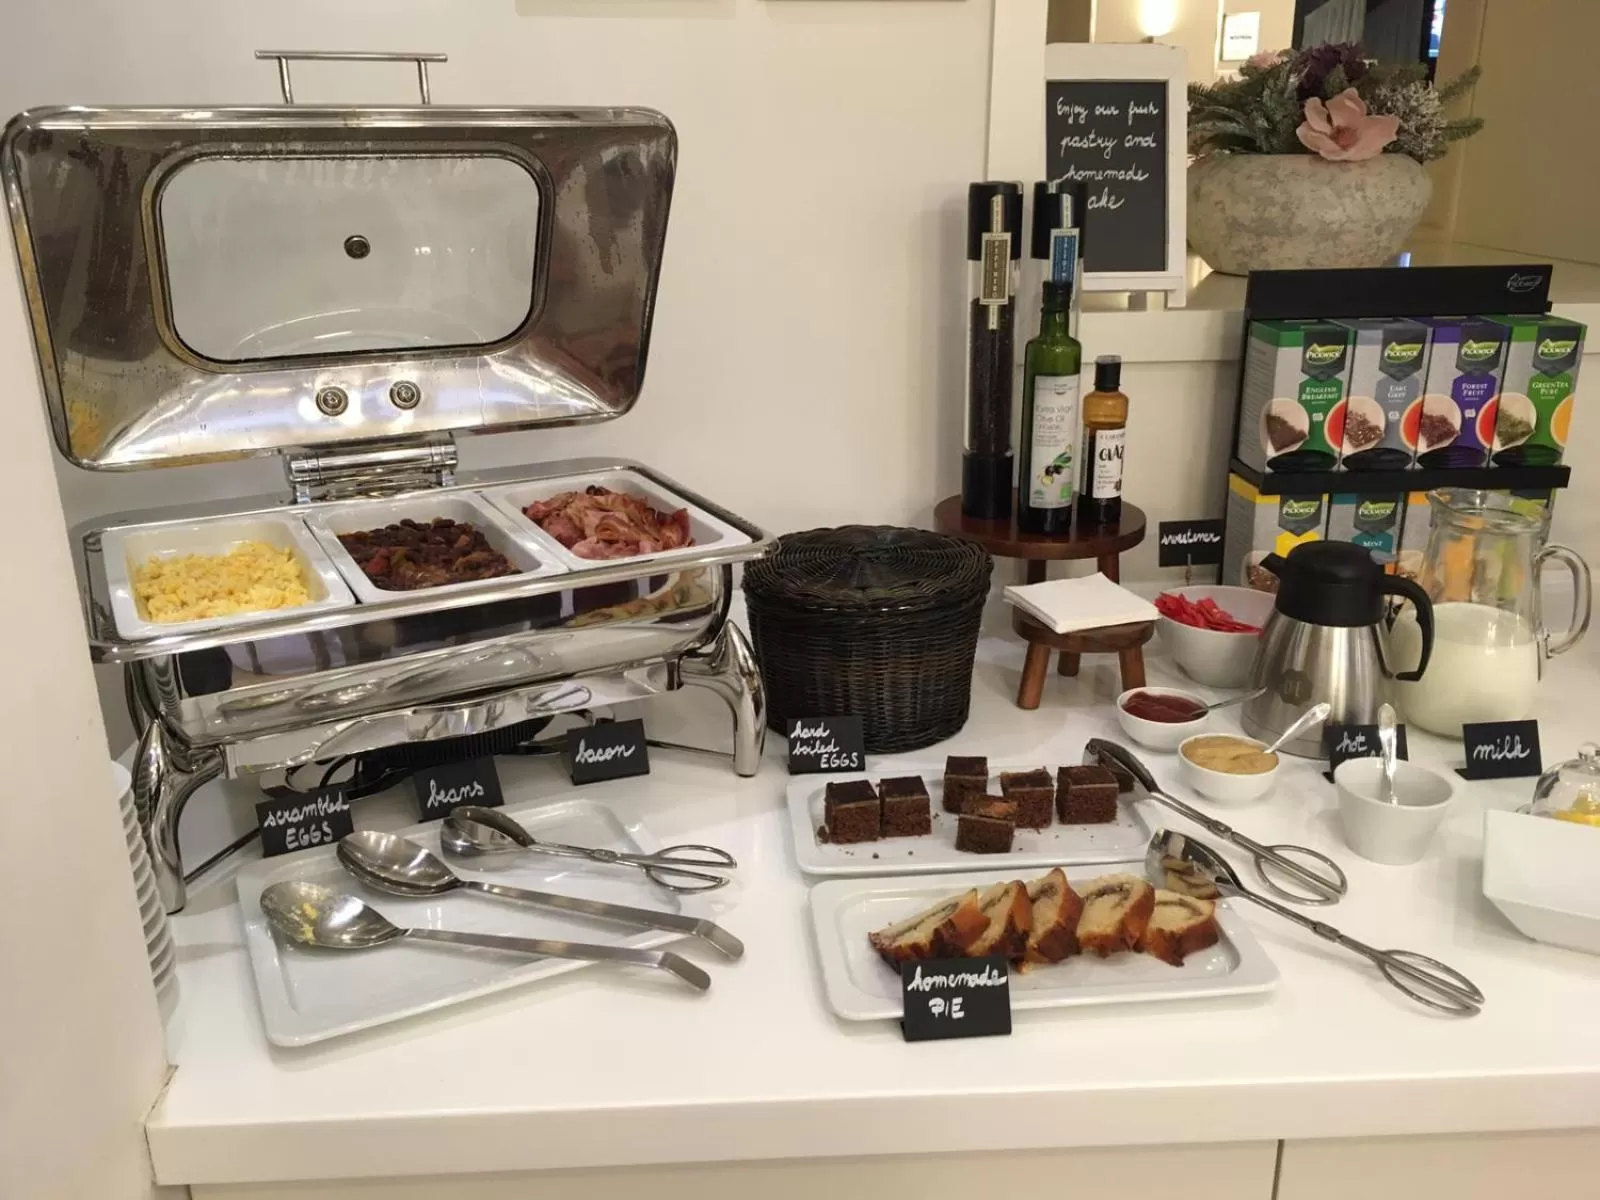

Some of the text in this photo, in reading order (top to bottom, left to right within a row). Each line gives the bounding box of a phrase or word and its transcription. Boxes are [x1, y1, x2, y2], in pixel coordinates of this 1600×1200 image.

[1057, 97, 1159, 126] Enjoy our fresh
[1061, 128, 1156, 159] pastry and
[1052, 162, 1149, 183] homemade
[1087, 186, 1125, 209] ake
[790, 720, 830, 739] hard
[1336, 731, 1368, 752] hot
[575, 738, 636, 764] bacon
[792, 738, 840, 756] boiled
[1473, 735, 1531, 760] milk
[820, 752, 859, 768] EGGS
[426, 778, 485, 808] beans
[263, 791, 350, 828] scrambled
[285, 820, 333, 850] EGGS
[907, 964, 1008, 992] homemade
[928, 996, 965, 1019] PIE
